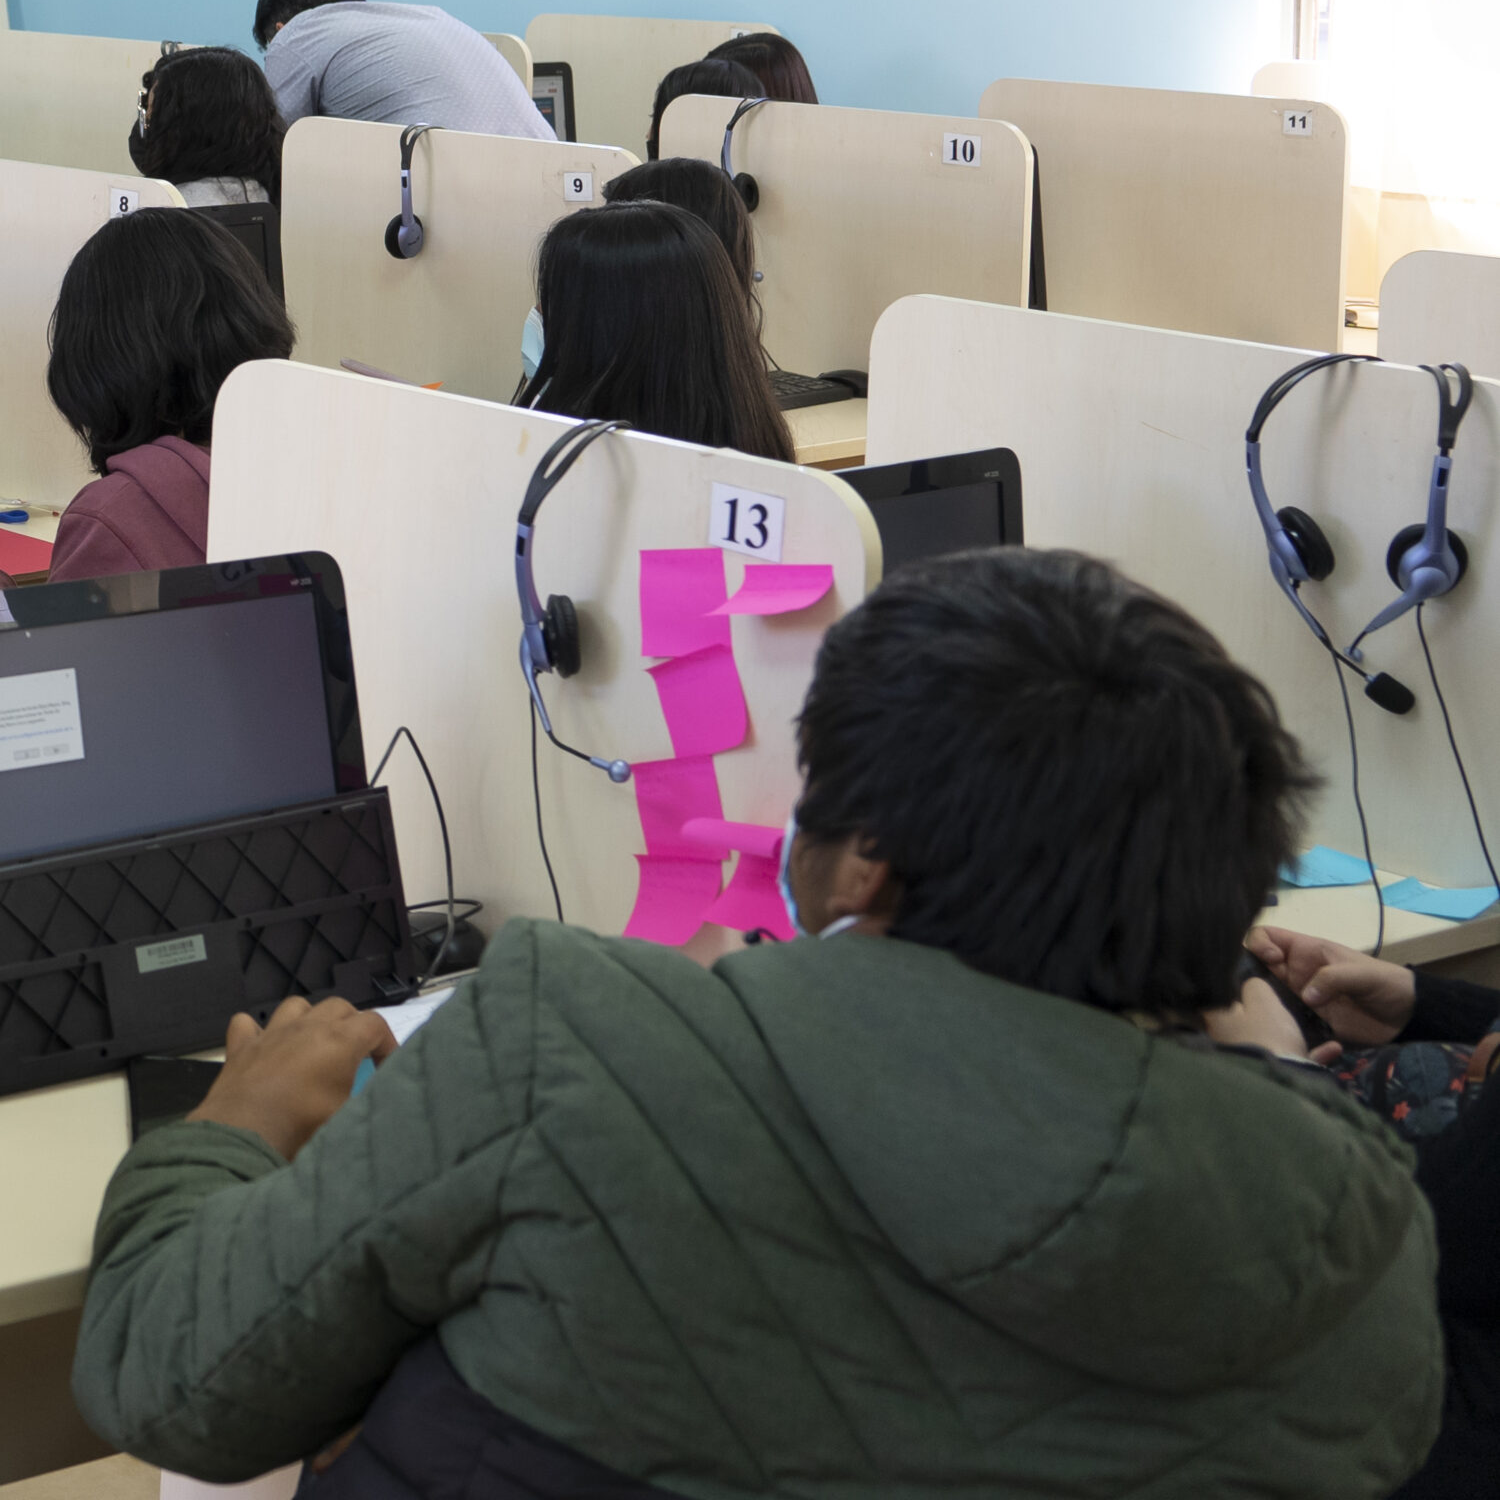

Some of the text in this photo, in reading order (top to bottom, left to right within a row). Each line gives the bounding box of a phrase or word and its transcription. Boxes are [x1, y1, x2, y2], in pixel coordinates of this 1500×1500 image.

[1287, 114, 1309, 130] 11
[948, 137, 976, 164] 10
[573, 177, 584, 193] 9
[119, 195, 129, 213] 8
[721, 497, 769, 550] 13
